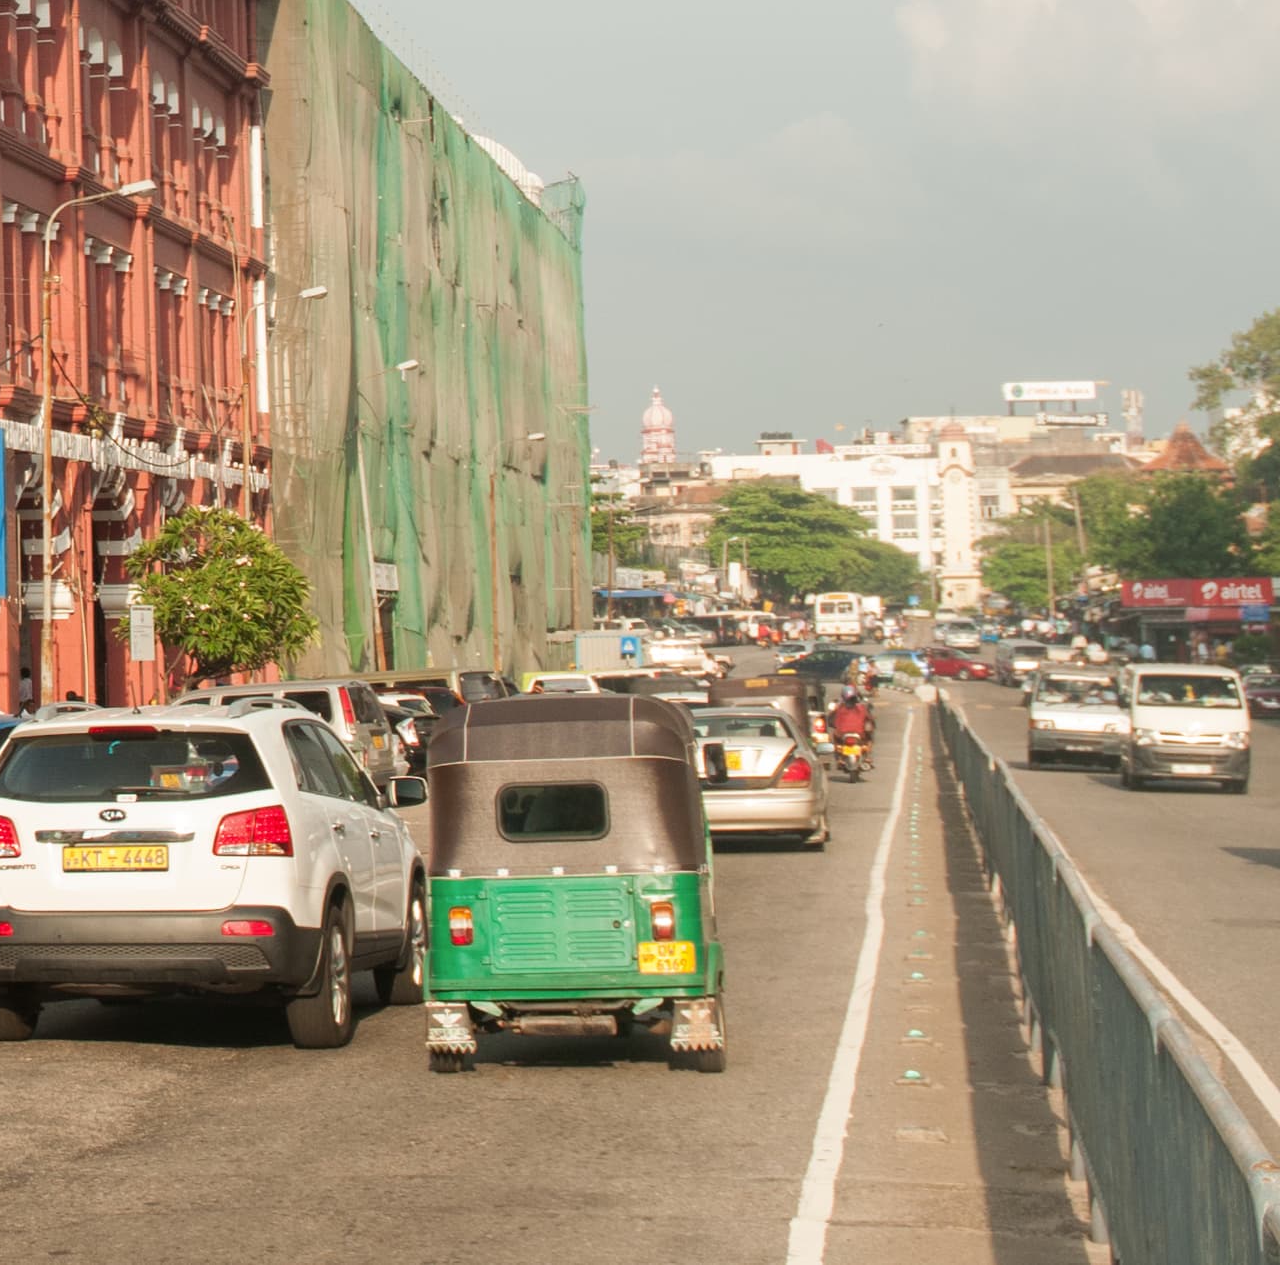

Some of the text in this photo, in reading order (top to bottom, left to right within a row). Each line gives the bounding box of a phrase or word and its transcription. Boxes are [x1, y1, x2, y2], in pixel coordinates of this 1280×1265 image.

[1144, 582, 1263, 599] airtel airtel
[100, 809, 126, 821] KIA
[123, 849, 166, 866] 4448
